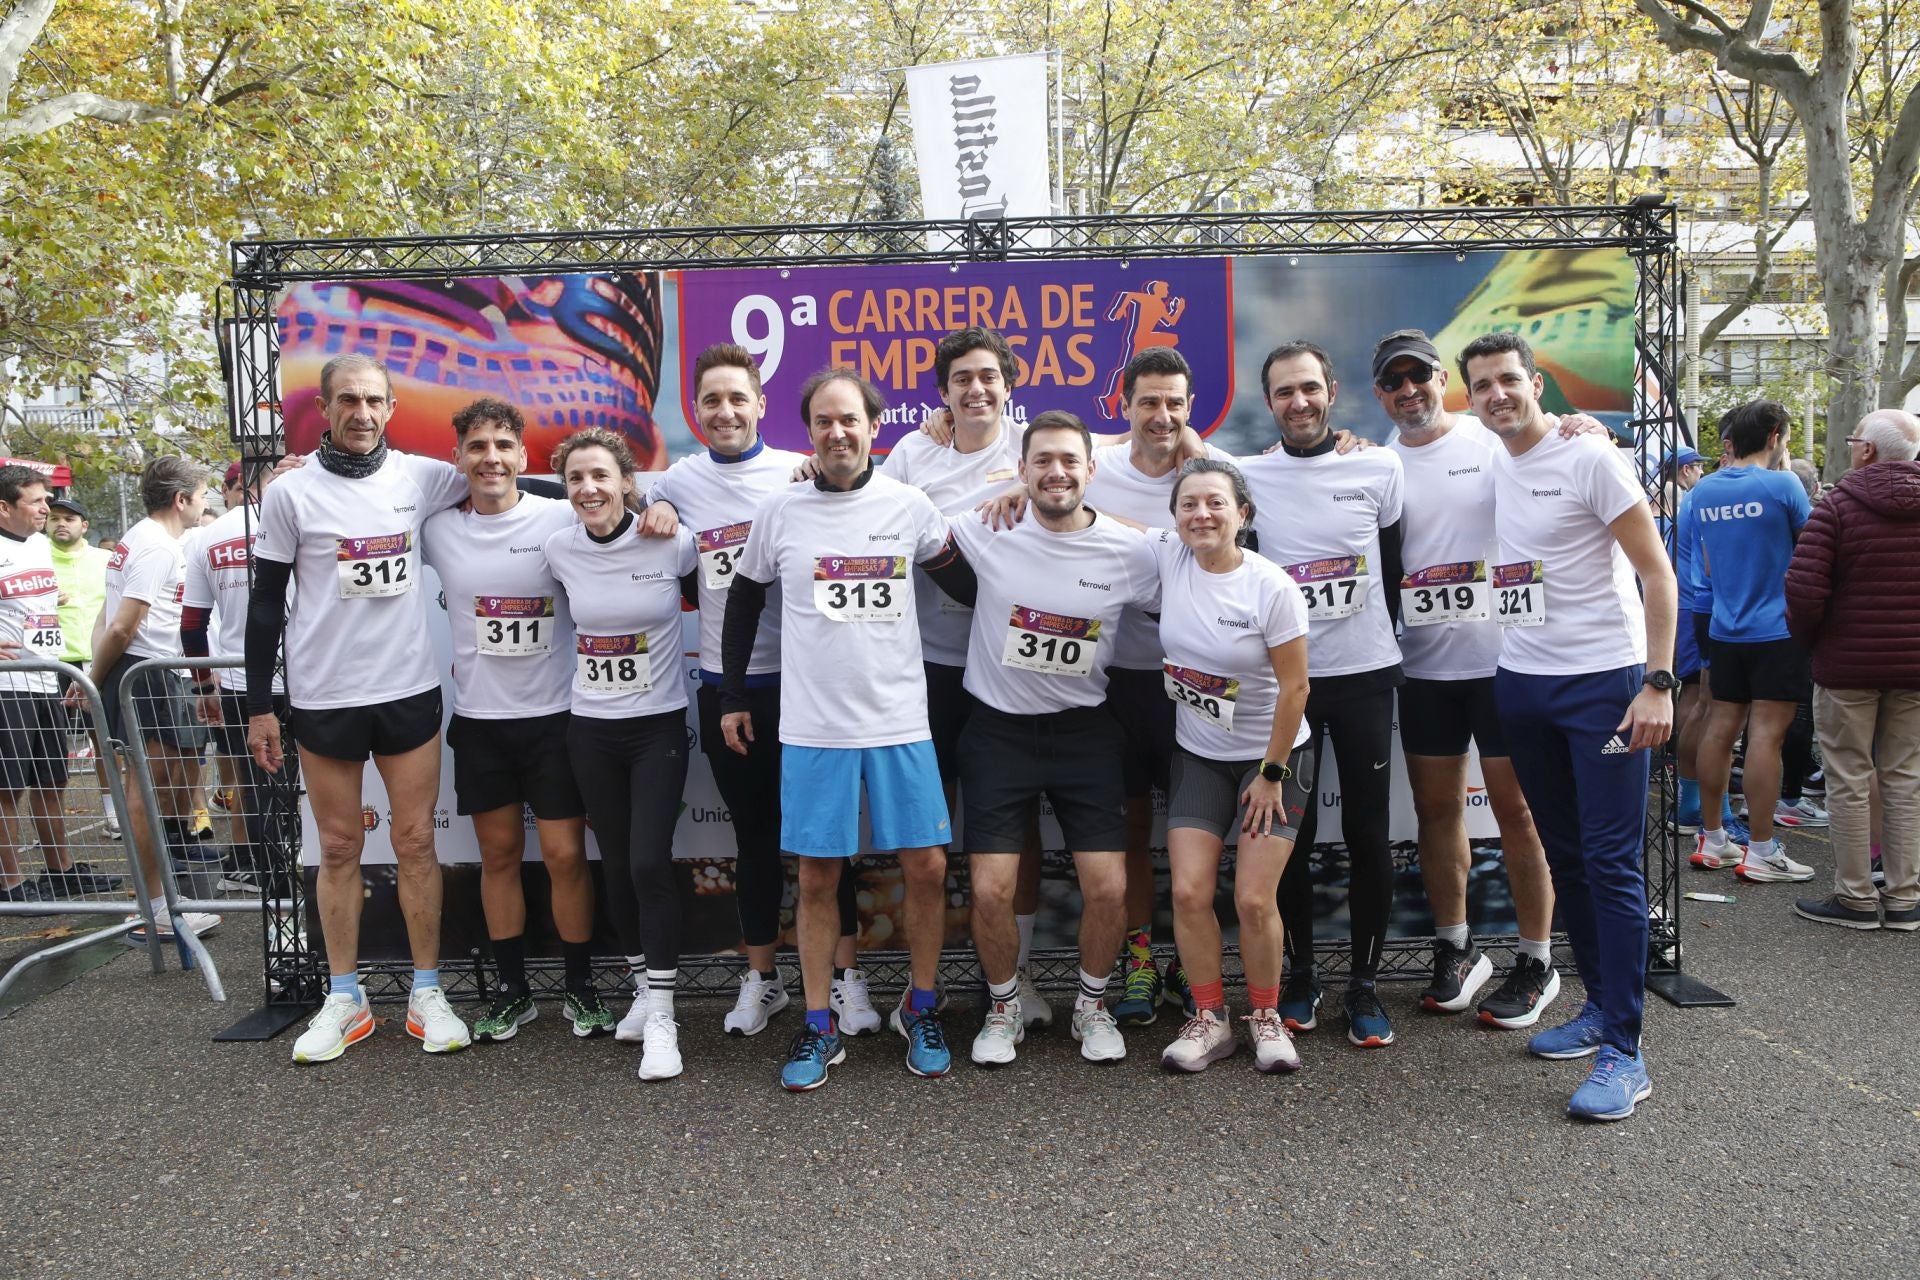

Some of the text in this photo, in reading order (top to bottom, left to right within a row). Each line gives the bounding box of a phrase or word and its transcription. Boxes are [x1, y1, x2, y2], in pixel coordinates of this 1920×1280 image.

[828, 287, 1028, 334] CARRERA
[1041, 284, 1095, 329] DE
[831, 333, 1095, 390] EMPSAS
[880, 402, 918, 425] orte
[1448, 465, 1480, 477] ferrovial
[1333, 492, 1365, 503] ferrovial
[1532, 487, 1562, 498] ferrovial
[393, 503, 417, 514] ferrovial
[1700, 501, 1763, 523] IVECO
[869, 531, 900, 542] ferrovial
[510, 544, 541, 554] ferrovial
[352, 558, 406, 586] 312
[632, 571, 664, 581] ferrovial
[828, 582, 892, 608] 313
[1079, 579, 1111, 592] ferrovial
[1300, 580, 1357, 609] 317
[1414, 586, 1474, 613] 319
[1499, 588, 1532, 615] 321
[487, 620, 539, 644] 311
[1217, 616, 1250, 629] ferrovial
[32, 630, 62, 646] 458
[1018, 632, 1080, 664] 310
[586, 658, 637, 682] 318
[1172, 681, 1220, 718] 320
[1601, 746, 1630, 754] adidas
[692, 808, 731, 823] Unic
